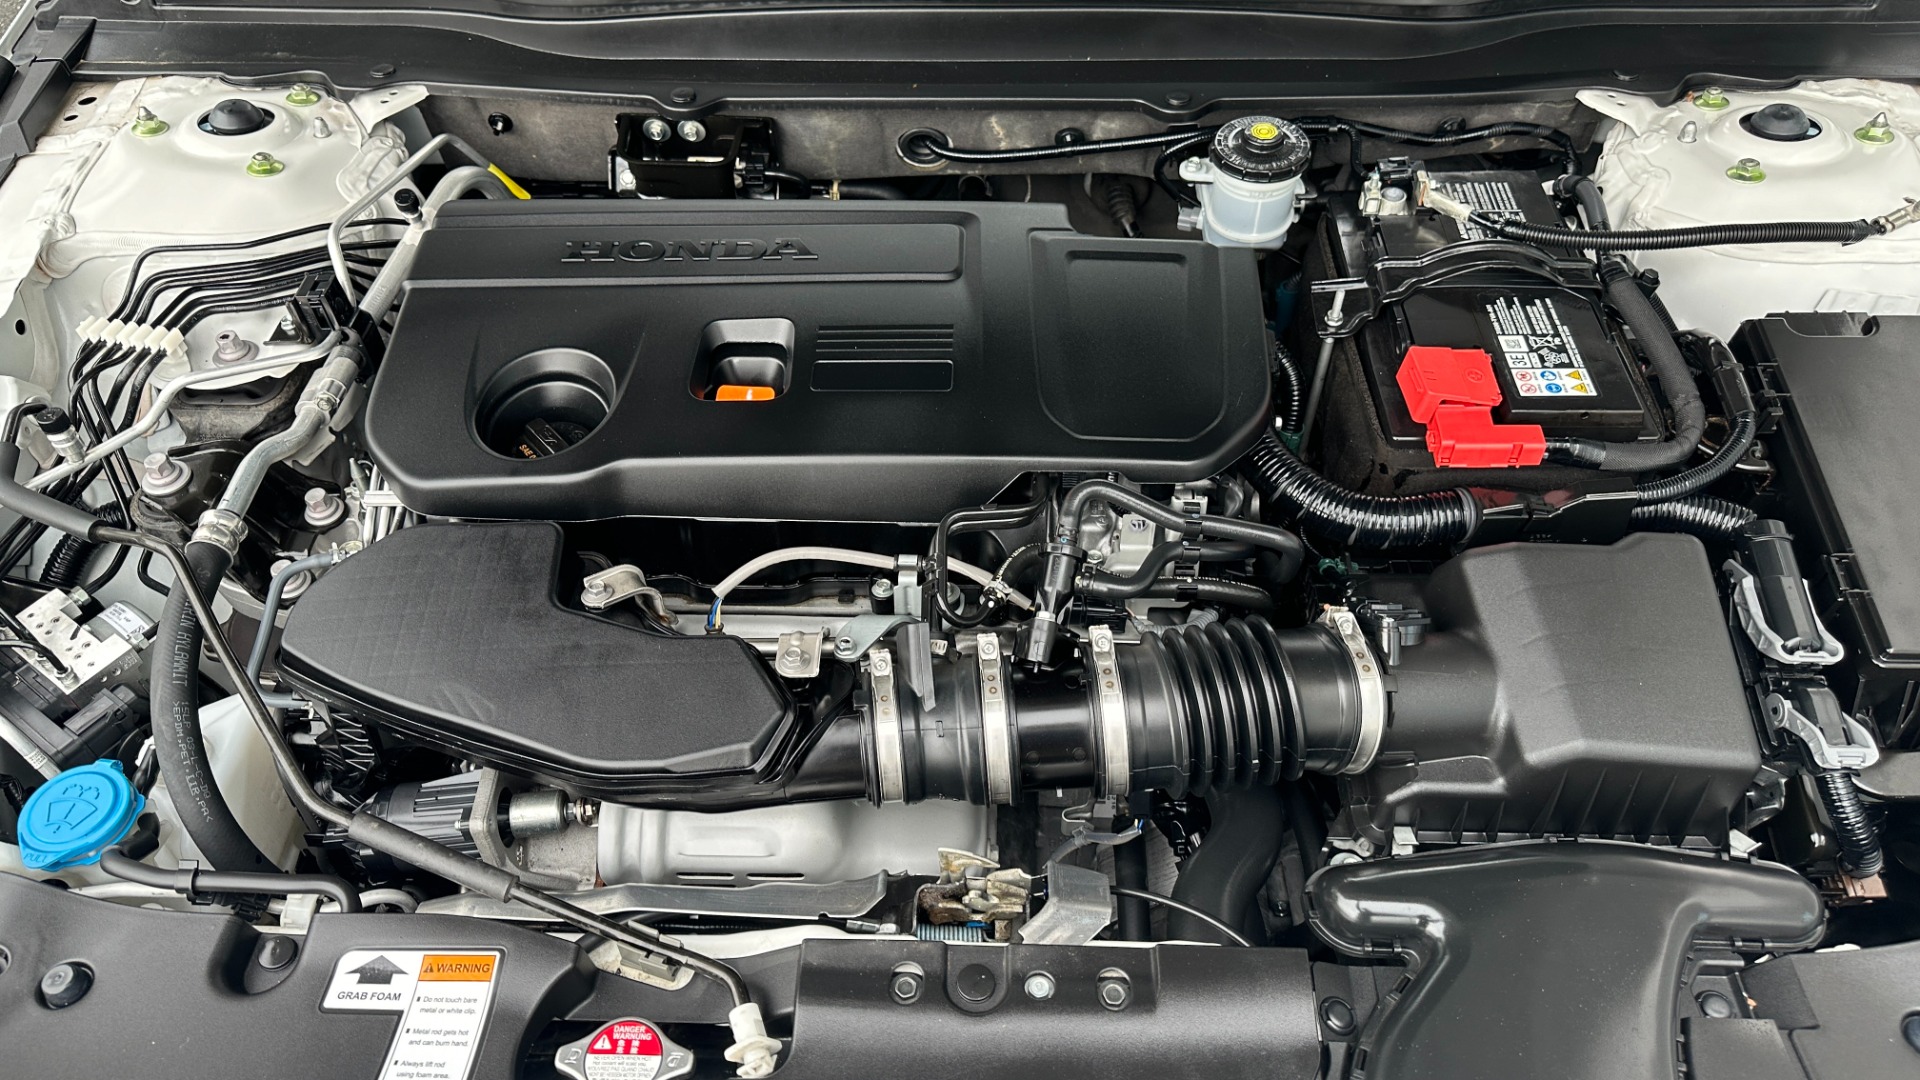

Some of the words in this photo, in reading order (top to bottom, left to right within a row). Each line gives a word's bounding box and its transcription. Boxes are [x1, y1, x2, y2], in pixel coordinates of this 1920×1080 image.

[561, 237, 818, 262] HONDA
[437, 963, 490, 973] WARNING
[337, 991, 368, 1000] GRAB
[370, 991, 401, 1001] FOAM
[443, 1029, 457, 1037] gets
[614, 1025, 646, 1033] DANGER
[613, 1032, 652, 1040] WARNUNG
[400, 1060, 424, 1068] Always
[396, 1071, 415, 1079] using
